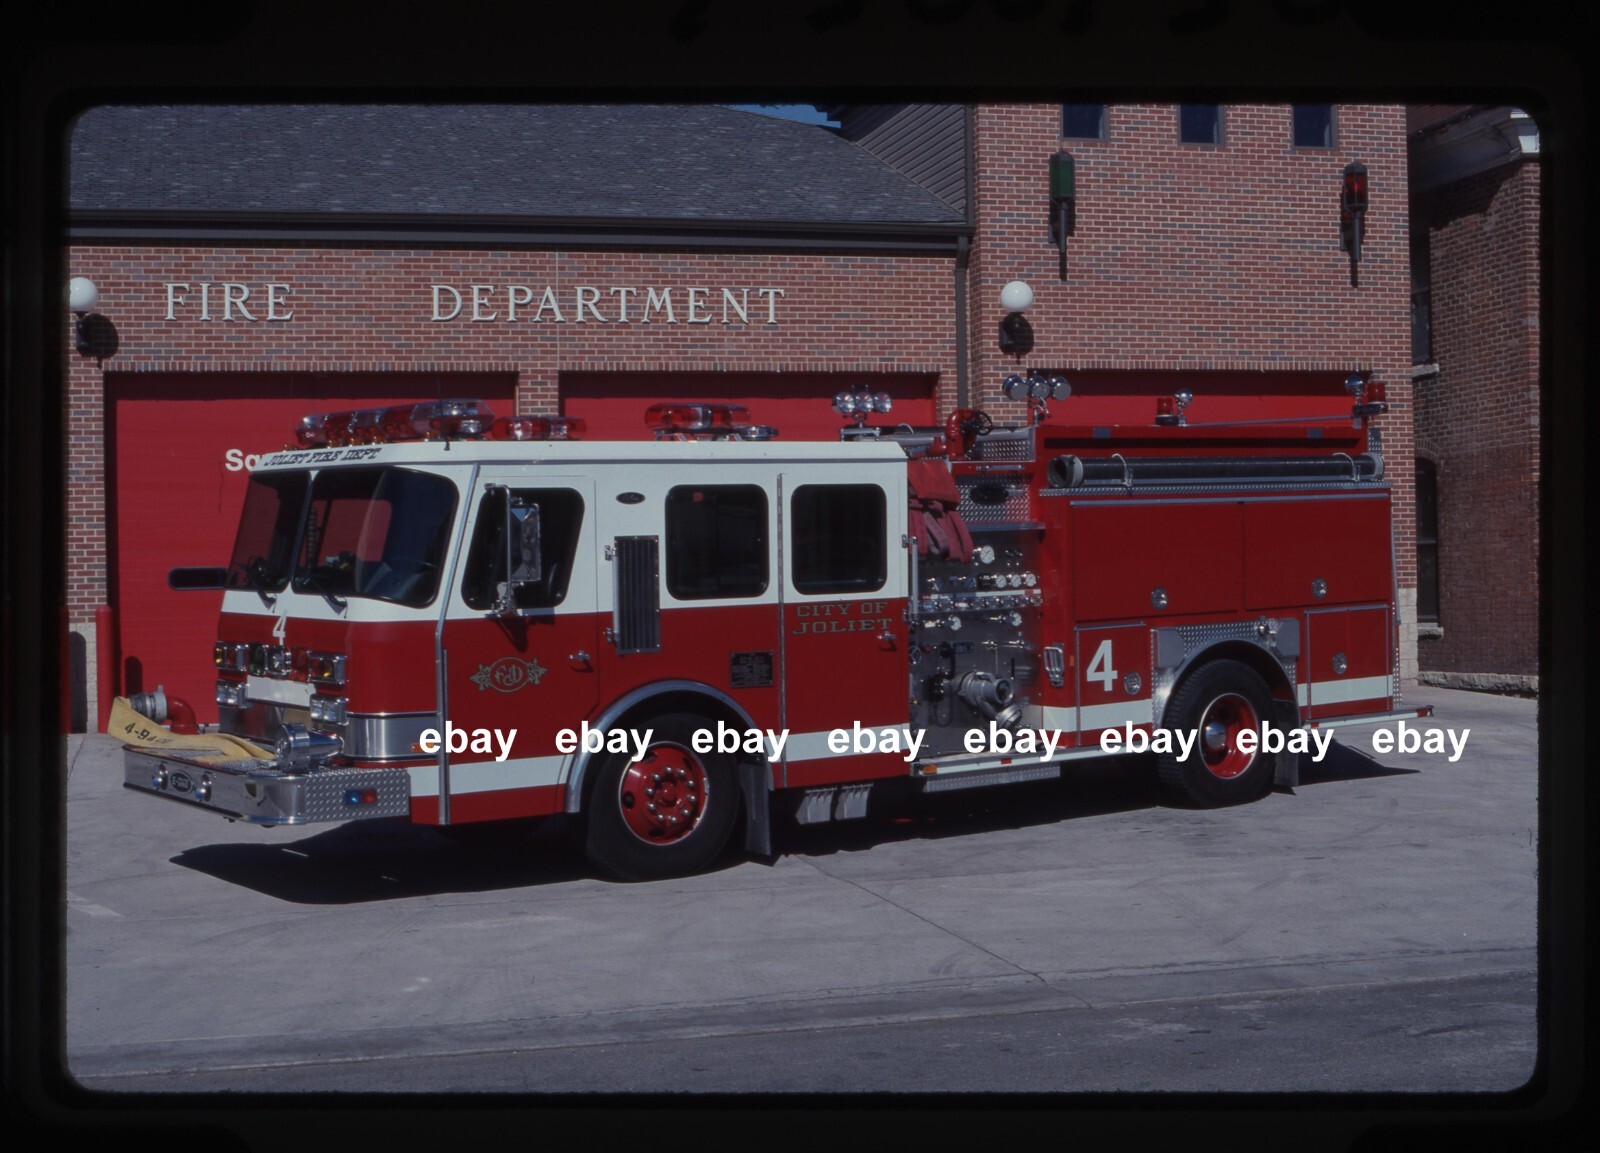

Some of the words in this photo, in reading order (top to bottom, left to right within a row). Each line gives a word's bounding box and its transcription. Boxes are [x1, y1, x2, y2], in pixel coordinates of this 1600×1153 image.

[165, 283, 294, 322] FIRE
[431, 284, 785, 325] DEPARTMENT
[306, 450, 343, 463] FIRE
[797, 603, 852, 617] CITY
[861, 601, 888, 614] OF
[273, 610, 287, 646] 4
[792, 618, 893, 635] JOLIET
[1086, 639, 1118, 692] 4
